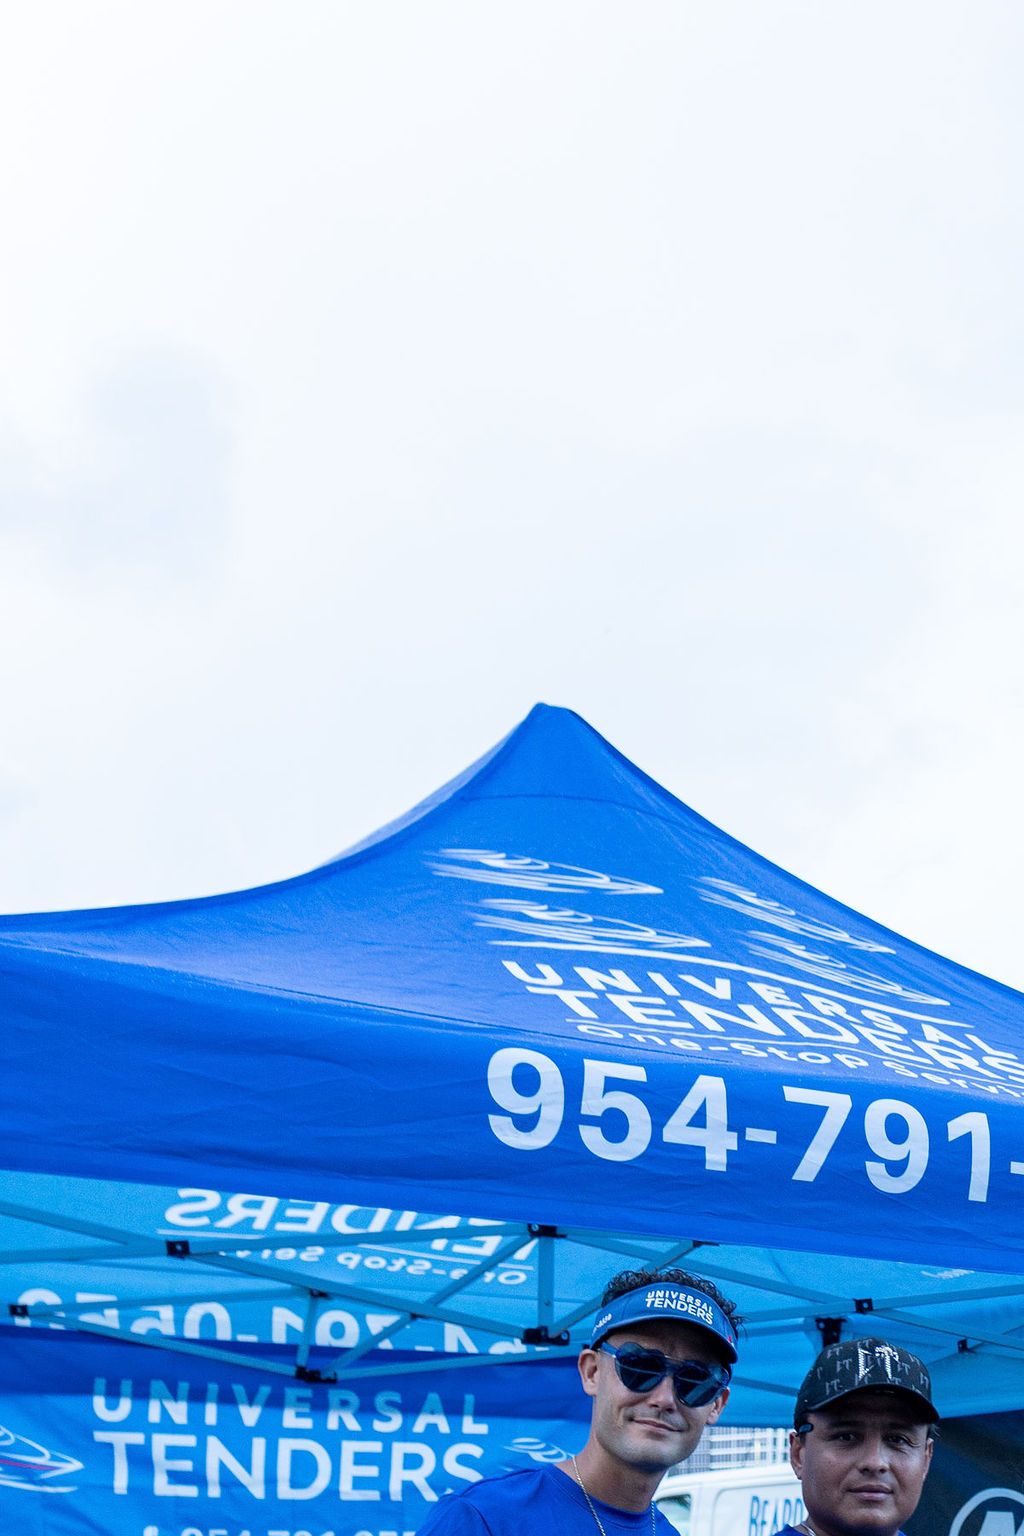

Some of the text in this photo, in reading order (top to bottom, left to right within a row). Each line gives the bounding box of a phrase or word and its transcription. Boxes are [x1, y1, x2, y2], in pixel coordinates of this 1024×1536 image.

[501, 960, 1019, 1060] UNIVERSAL
[576, 1024, 869, 1069] One-Stop
[645, 1298, 714, 1325] TENDERS
[647, 1290, 714, 1317] UNIVERSAL
[92, 1378, 489, 1435] UNIVERSAL
[93, 1431, 485, 1502] TENDERS
